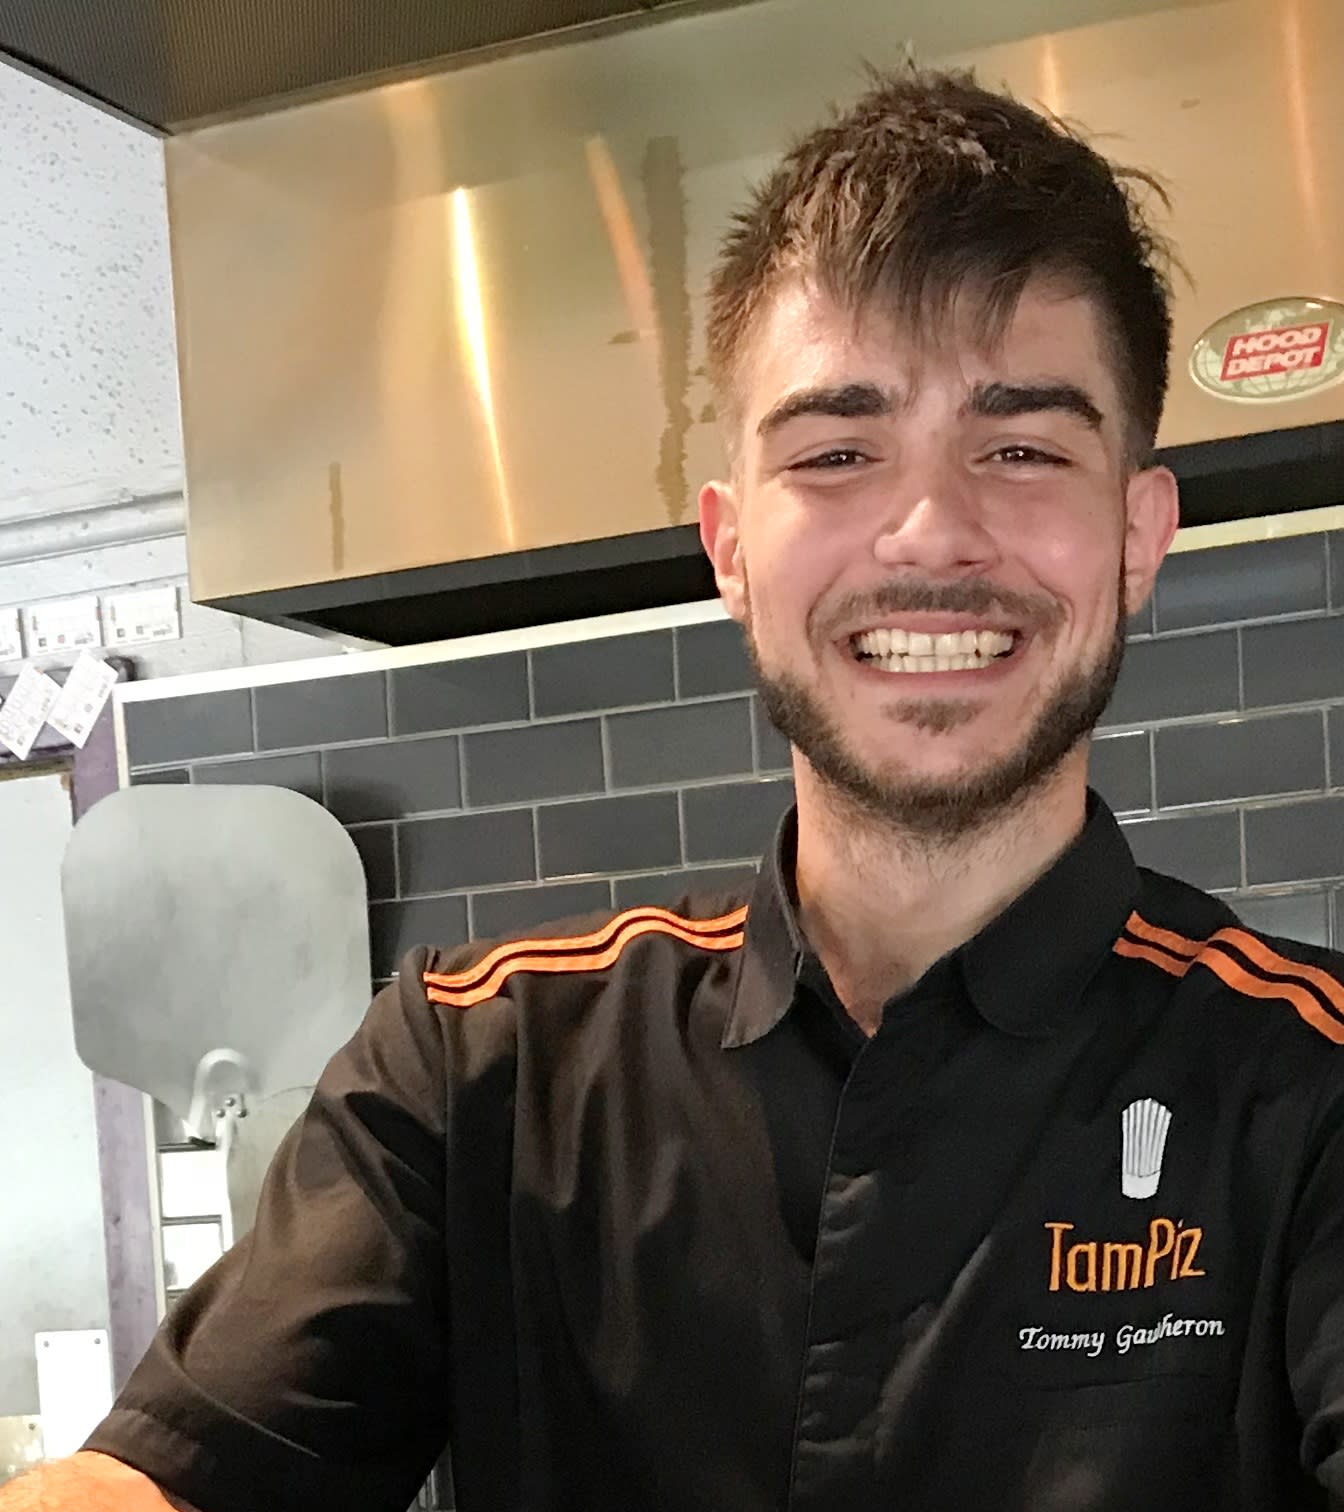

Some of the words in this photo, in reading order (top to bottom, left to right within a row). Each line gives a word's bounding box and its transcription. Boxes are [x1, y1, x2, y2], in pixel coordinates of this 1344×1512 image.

[1231, 326, 1323, 356] HOOD
[1226, 346, 1321, 376] DEPOT
[1044, 1217, 1206, 1292] TamPiz
[1019, 1325, 1105, 1357] Tommy
